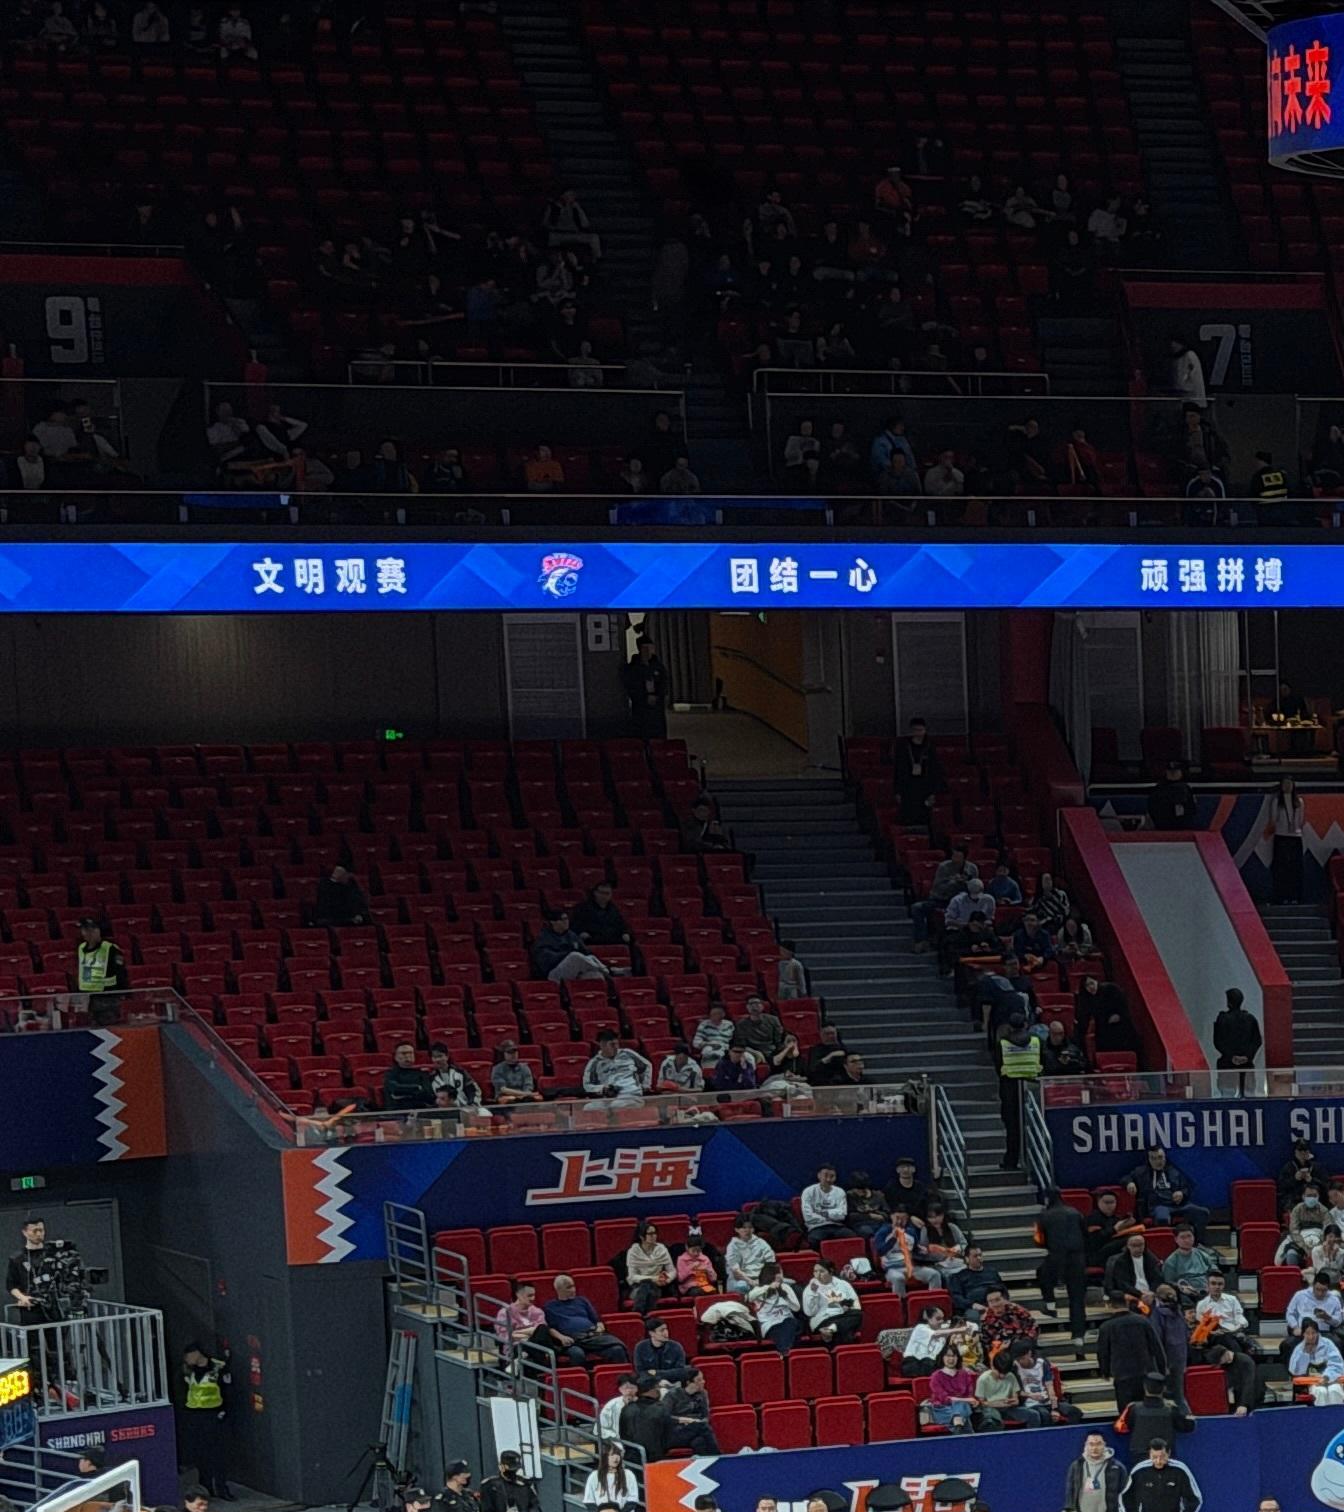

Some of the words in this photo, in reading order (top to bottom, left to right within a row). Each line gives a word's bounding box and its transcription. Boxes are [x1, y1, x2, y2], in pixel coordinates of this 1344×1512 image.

[45, 296, 88, 363] 9
[1199, 323, 1236, 385] 7
[253, 556, 408, 595] 文明观赛
[730, 557, 879, 594] 团结一心
[1141, 557, 1284, 593] 顽强拼搏
[586, 613, 611, 652] 8
[1073, 1108, 1264, 1153] SHANGHAI
[525, 1145, 706, 1206] 上海
[49, 1431, 105, 1449] SHANGHAI
